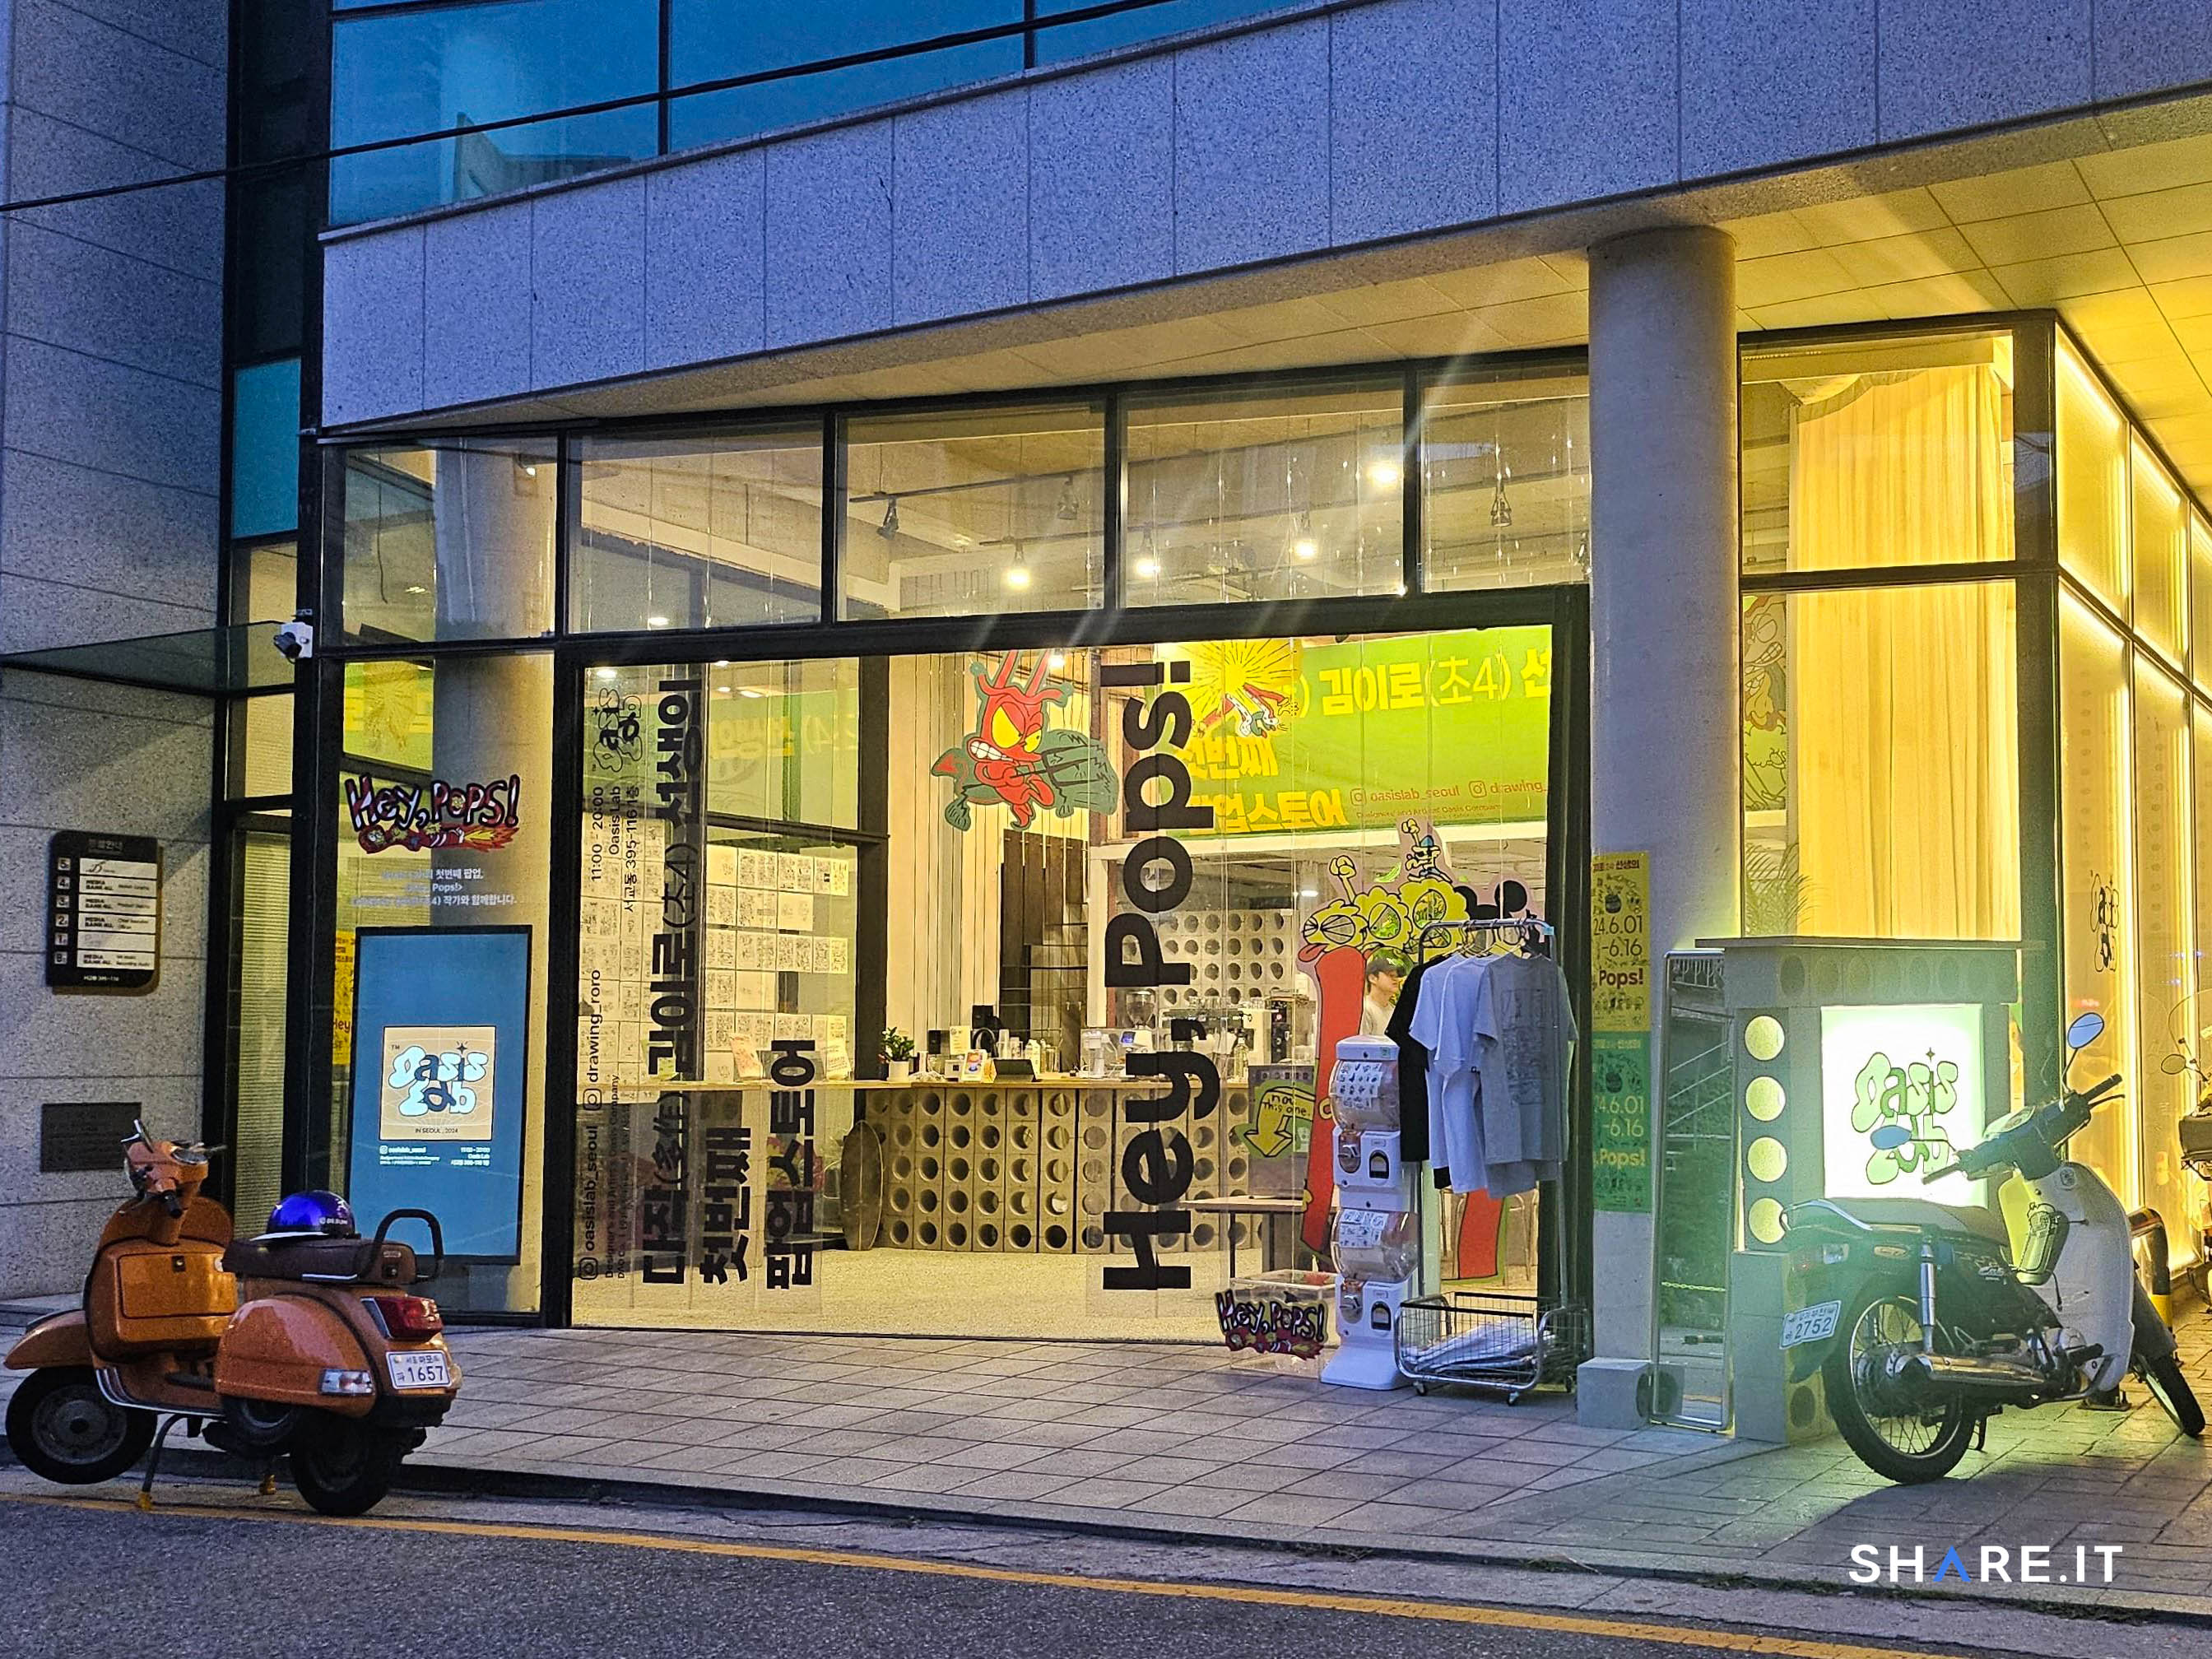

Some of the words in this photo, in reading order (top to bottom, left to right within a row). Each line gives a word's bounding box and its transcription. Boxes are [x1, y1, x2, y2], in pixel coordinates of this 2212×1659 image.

[592, 687, 622, 772] Oasis
[591, 787, 604, 830] 20:00
[607, 786, 621, 813] Lab
[1099, 660, 1214, 988] Pops!
[607, 816, 621, 855] Oasis
[624, 808, 639, 869] 395-116
[591, 844, 604, 882] 11:00
[623, 874, 639, 913] 서교동
[647, 843, 699, 1075] 김이로(초4)
[1599, 968, 1644, 989] Pops!
[584, 969, 603, 1082] drawing_roro
[388, 1045, 489, 1089] Oasis
[1851, 1052, 1959, 1133] Oasis
[398, 1080, 476, 1117] Lab
[763, 1039, 816, 1290] 팝업스토어
[1103, 1020, 1220, 1290] Hey,
[583, 1125, 601, 1251] oasislab_seoul
[699, 1127, 751, 1286] 첫번째
[1794, 1317, 1832, 1340] 2752
[407, 1365, 444, 1382] 1657
